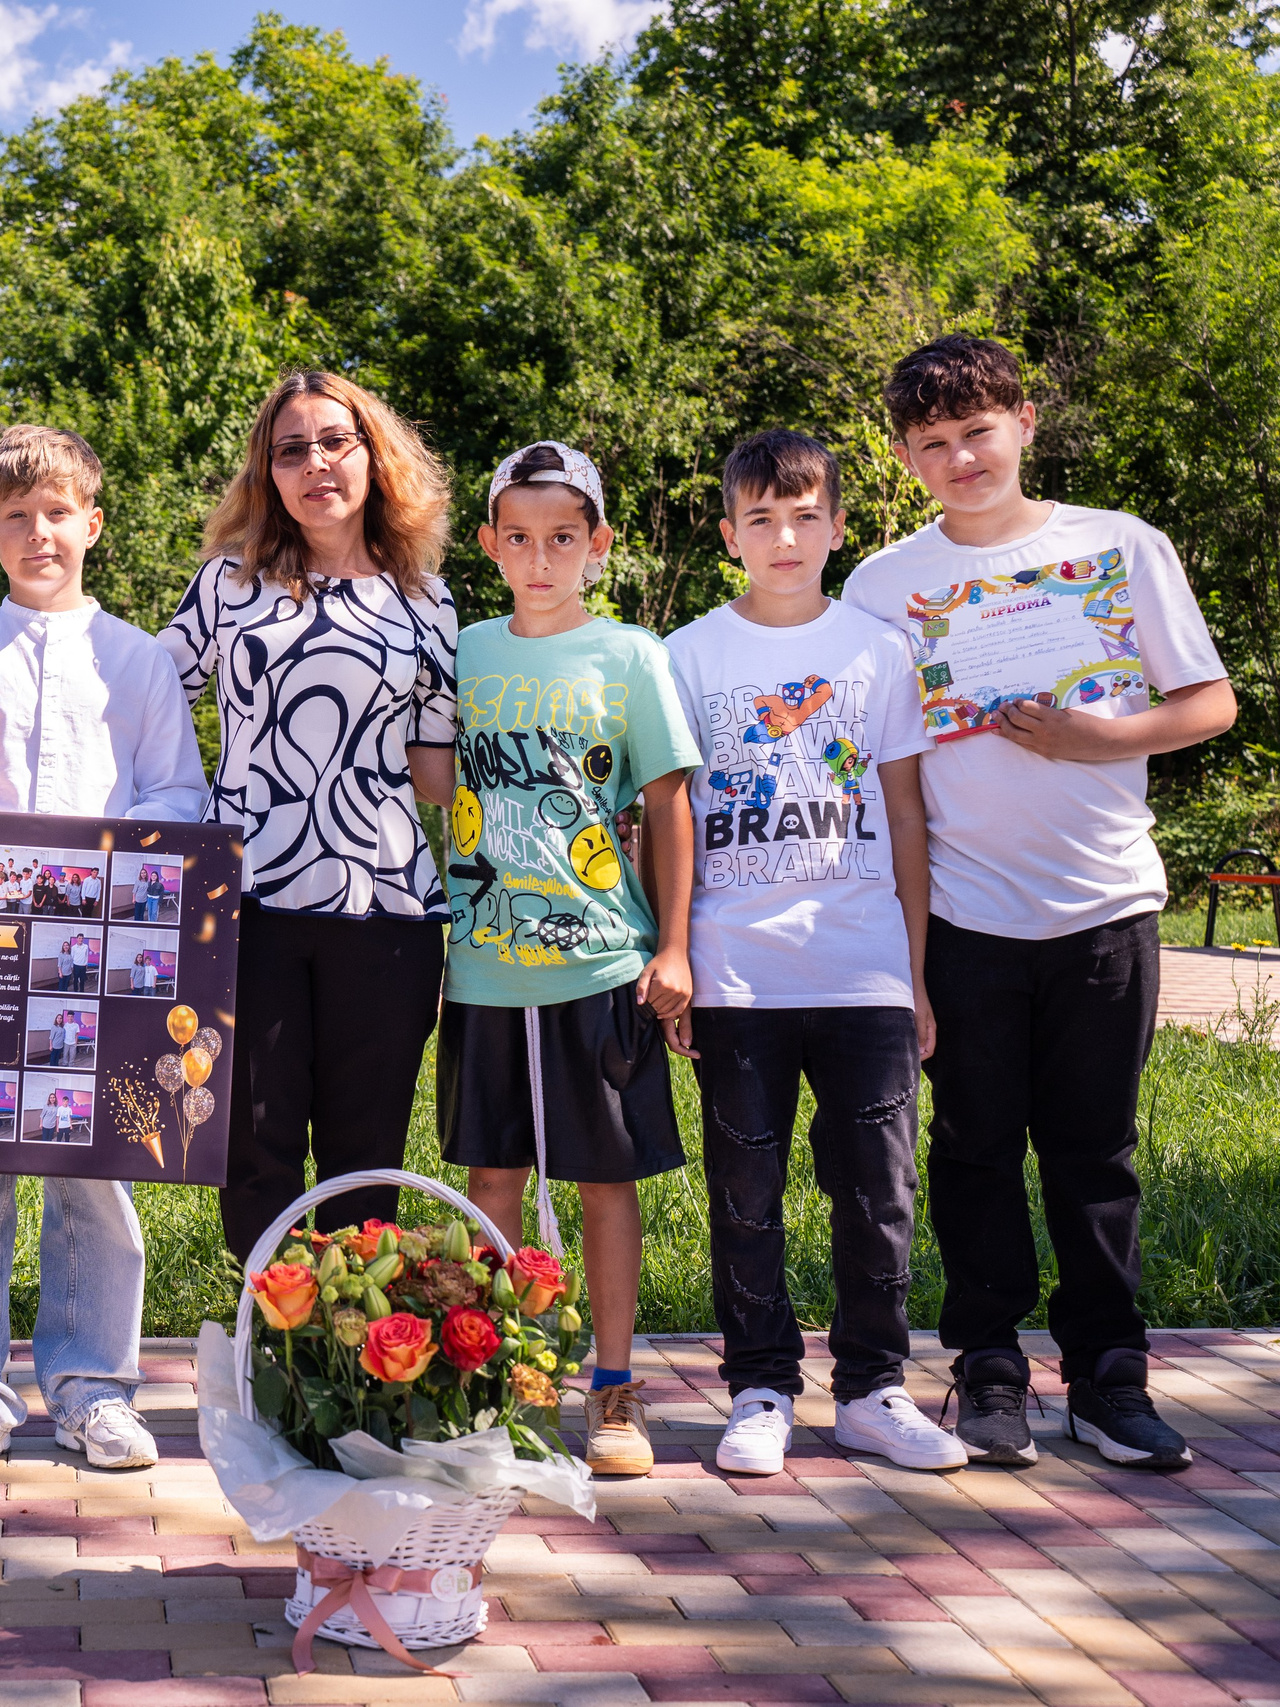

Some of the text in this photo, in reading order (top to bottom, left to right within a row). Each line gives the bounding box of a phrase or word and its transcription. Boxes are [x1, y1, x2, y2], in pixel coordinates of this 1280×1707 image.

[980, 597, 1052, 620] DIPLOMA
[705, 801, 876, 851] BRAWL
[703, 842, 880, 891] BRAWL
